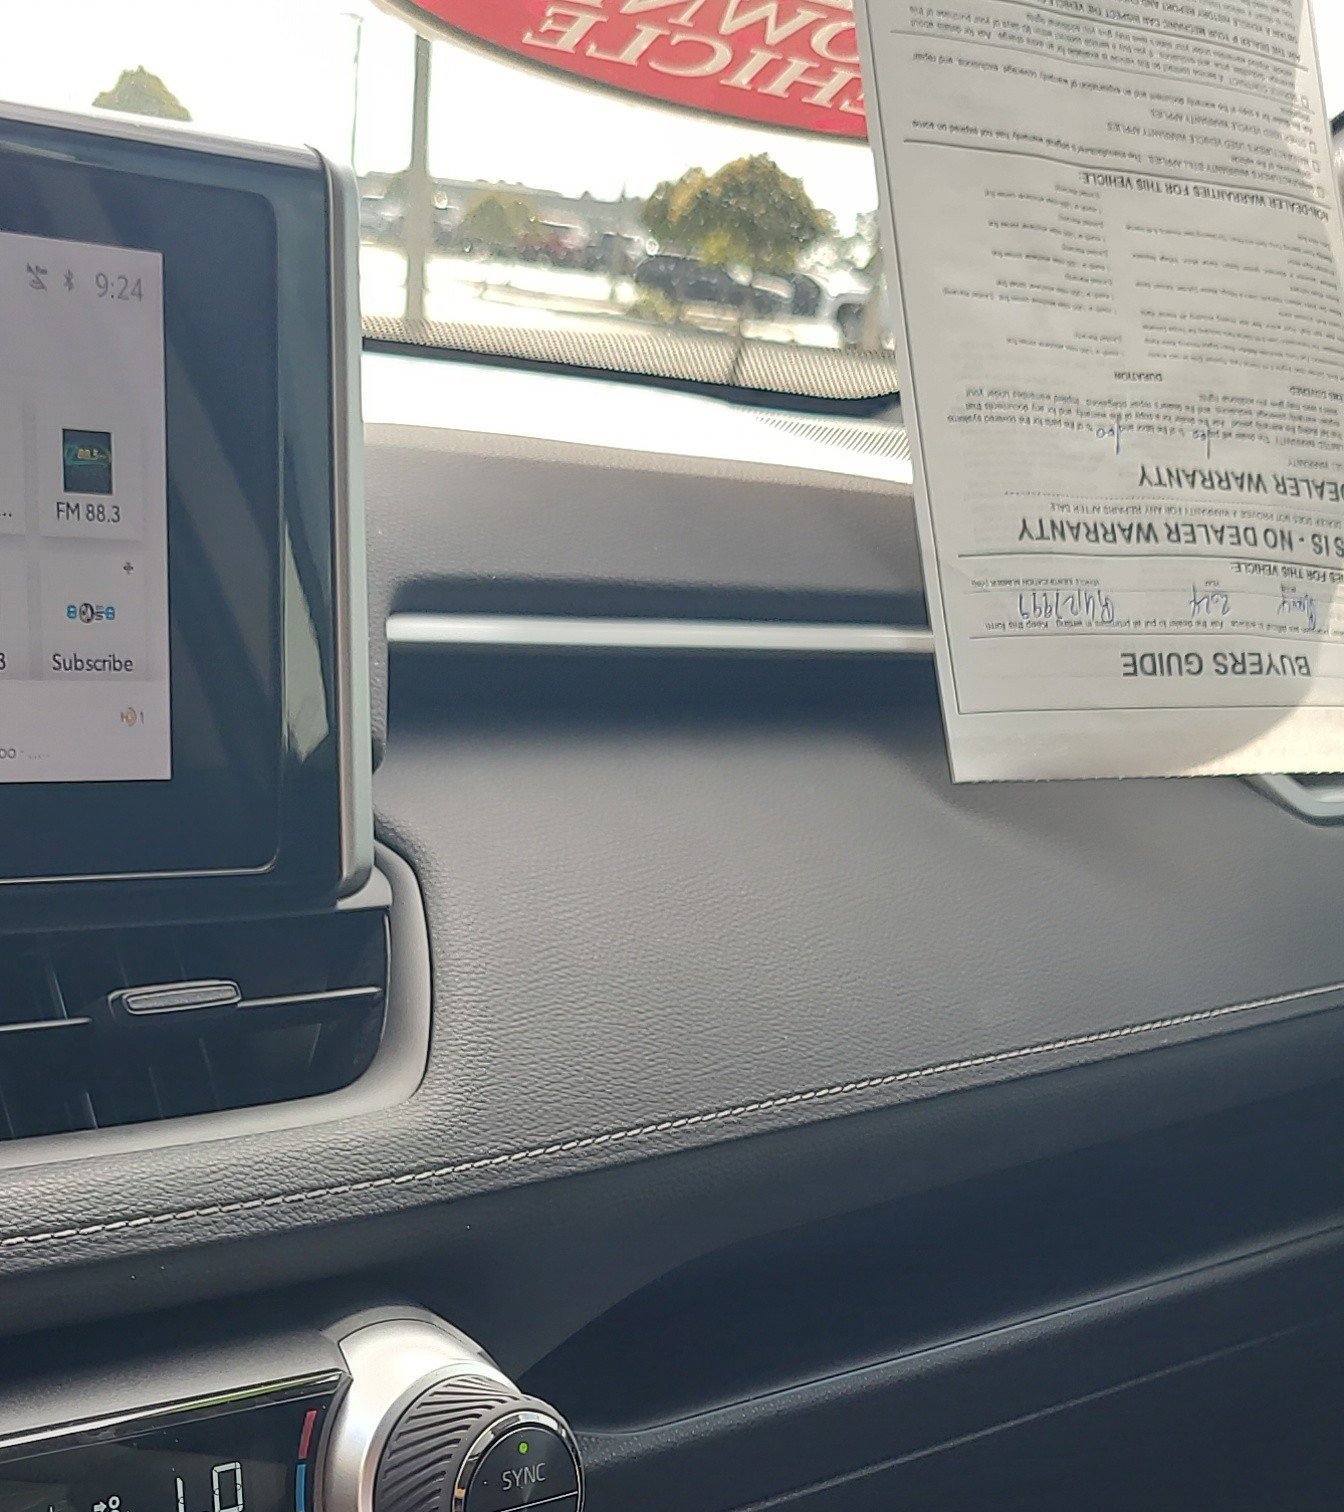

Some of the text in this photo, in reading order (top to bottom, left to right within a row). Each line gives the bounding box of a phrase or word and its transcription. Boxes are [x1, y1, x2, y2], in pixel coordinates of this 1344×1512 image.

[1134, 177, 1161, 193] THIS
[1163, 182, 1188, 196] FOR
[1192, 185, 1265, 207] WARRANTIES
[94, 271, 145, 302] 9:24
[1137, 464, 1266, 495] WARRANTY
[56, 501, 122, 524] FM 88.3
[1016, 517, 1158, 544] WARRANTY
[1163, 521, 1257, 547] DEALER
[1262, 526, 1292, 552] NO
[1310, 532, 1329, 557] IS
[1280, 565, 1302, 579] THIS
[1305, 569, 1325, 582] FOR
[52, 652, 134, 673] Subscribe
[1119, 650, 1311, 677] BUYERS GUIDE
[501, 1461, 547, 1492] SYNC
